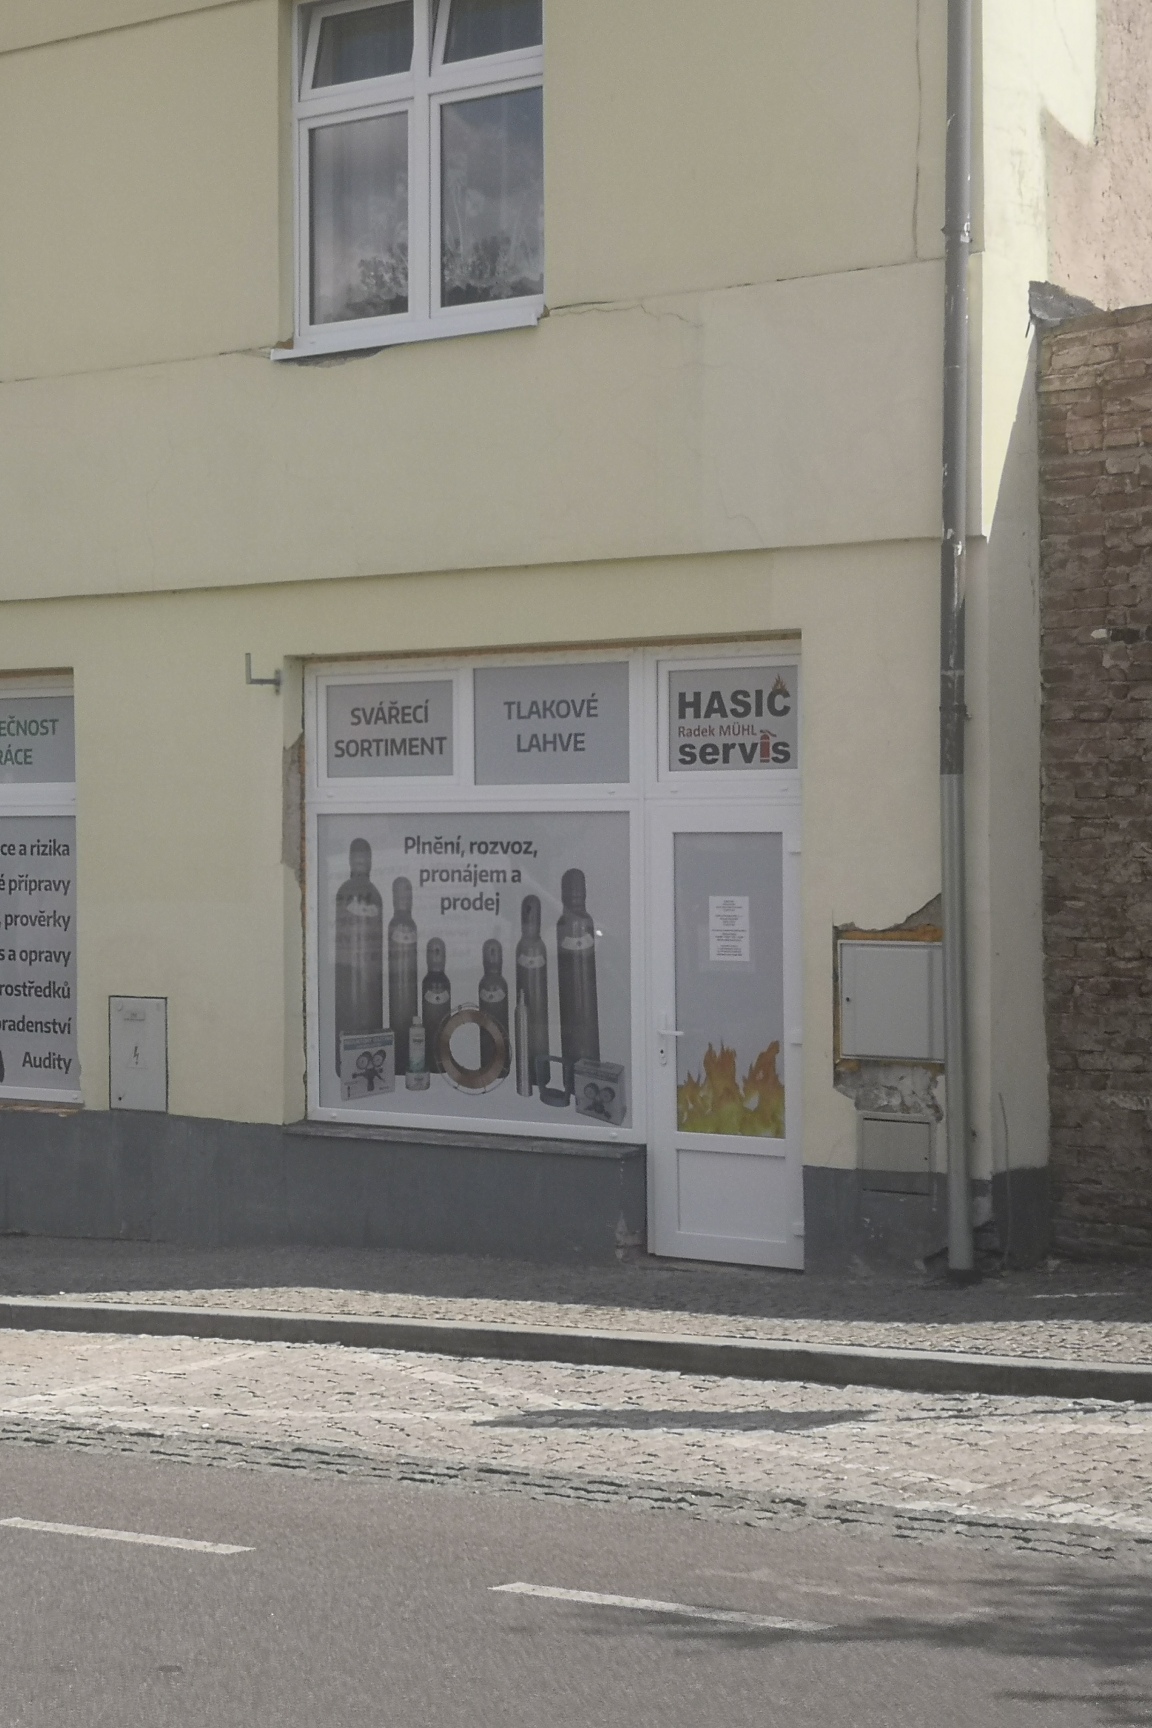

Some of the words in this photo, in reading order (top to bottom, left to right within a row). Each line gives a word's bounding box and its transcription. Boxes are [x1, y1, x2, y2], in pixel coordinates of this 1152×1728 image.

[350, 699, 430, 726] SVÁŘECÍ
[503, 693, 599, 720] TLAKOVÉ
[678, 725, 715, 738] Radek
[719, 722, 757, 737] MÜHL
[333, 736, 447, 758] SORTIMENT
[516, 732, 585, 753] LAHVE
[678, 729, 791, 765] servis
[19, 843, 27, 856] a
[30, 839, 70, 857] rizika
[404, 835, 464, 857] Plnění,
[469, 839, 538, 858] rozvoz,
[8, 874, 71, 896] přípravy
[419, 864, 507, 887] pronájem
[511, 868, 521, 883] a
[440, 893, 500, 915] prodej
[5, 910, 71, 932] prověrky
[8, 949, 16, 961] a
[19, 949, 71, 967] opravy
[22, 1051, 72, 1074] Audity
